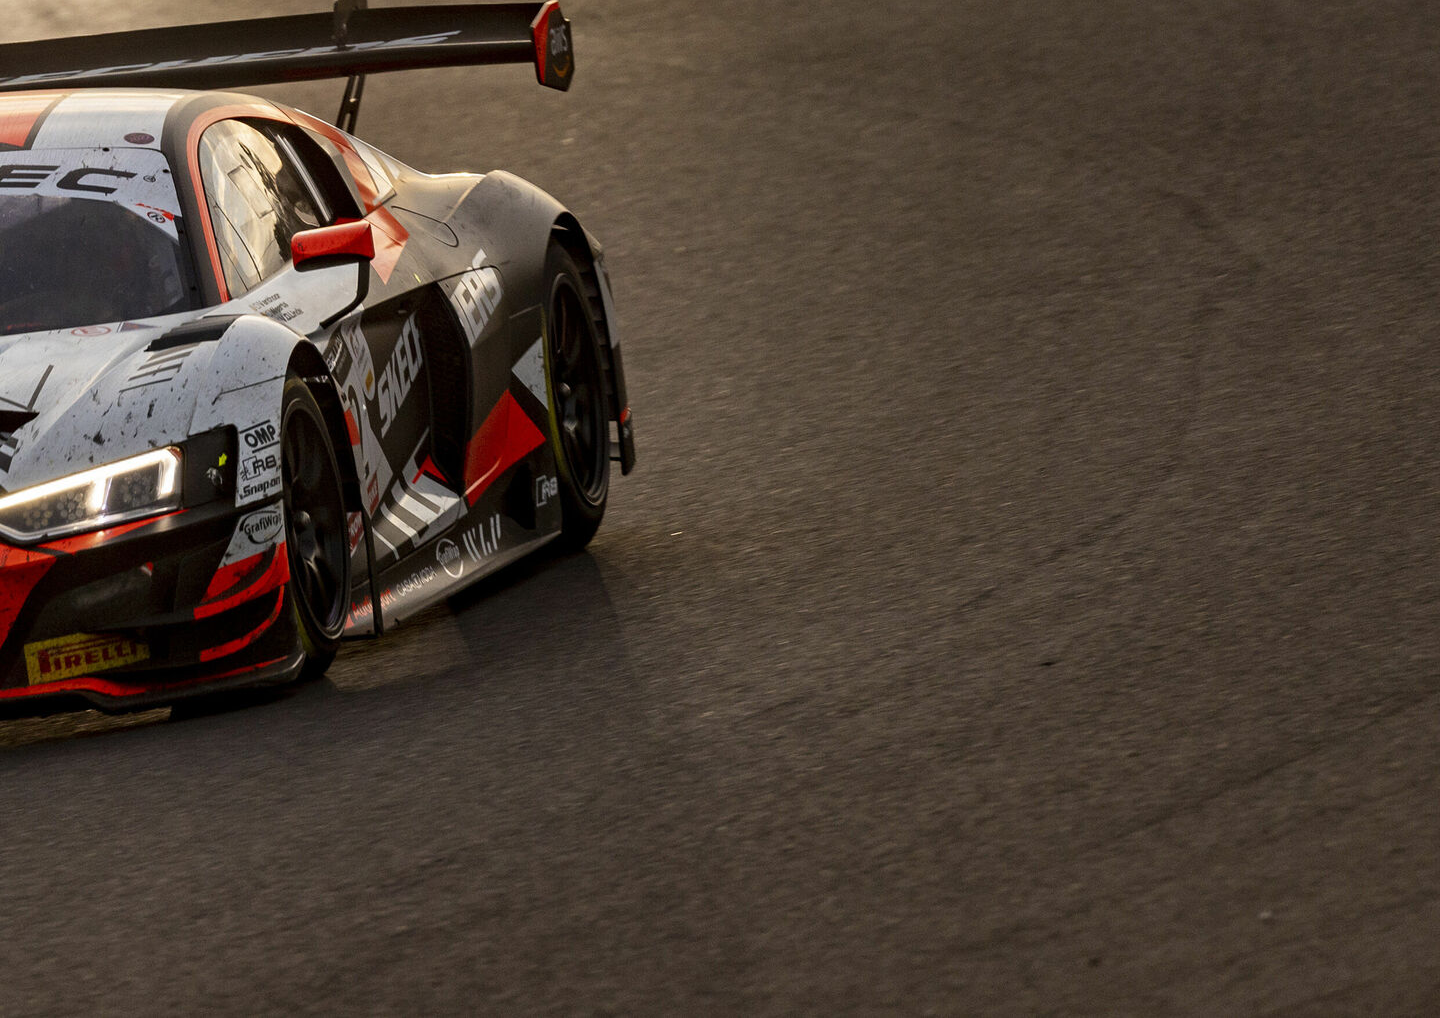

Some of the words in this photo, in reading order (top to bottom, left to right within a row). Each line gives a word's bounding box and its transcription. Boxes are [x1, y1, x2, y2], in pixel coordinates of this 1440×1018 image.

[244, 424, 276, 448] OMP
[252, 455, 277, 475] R8
[38, 636, 137, 675] PIRELLI
